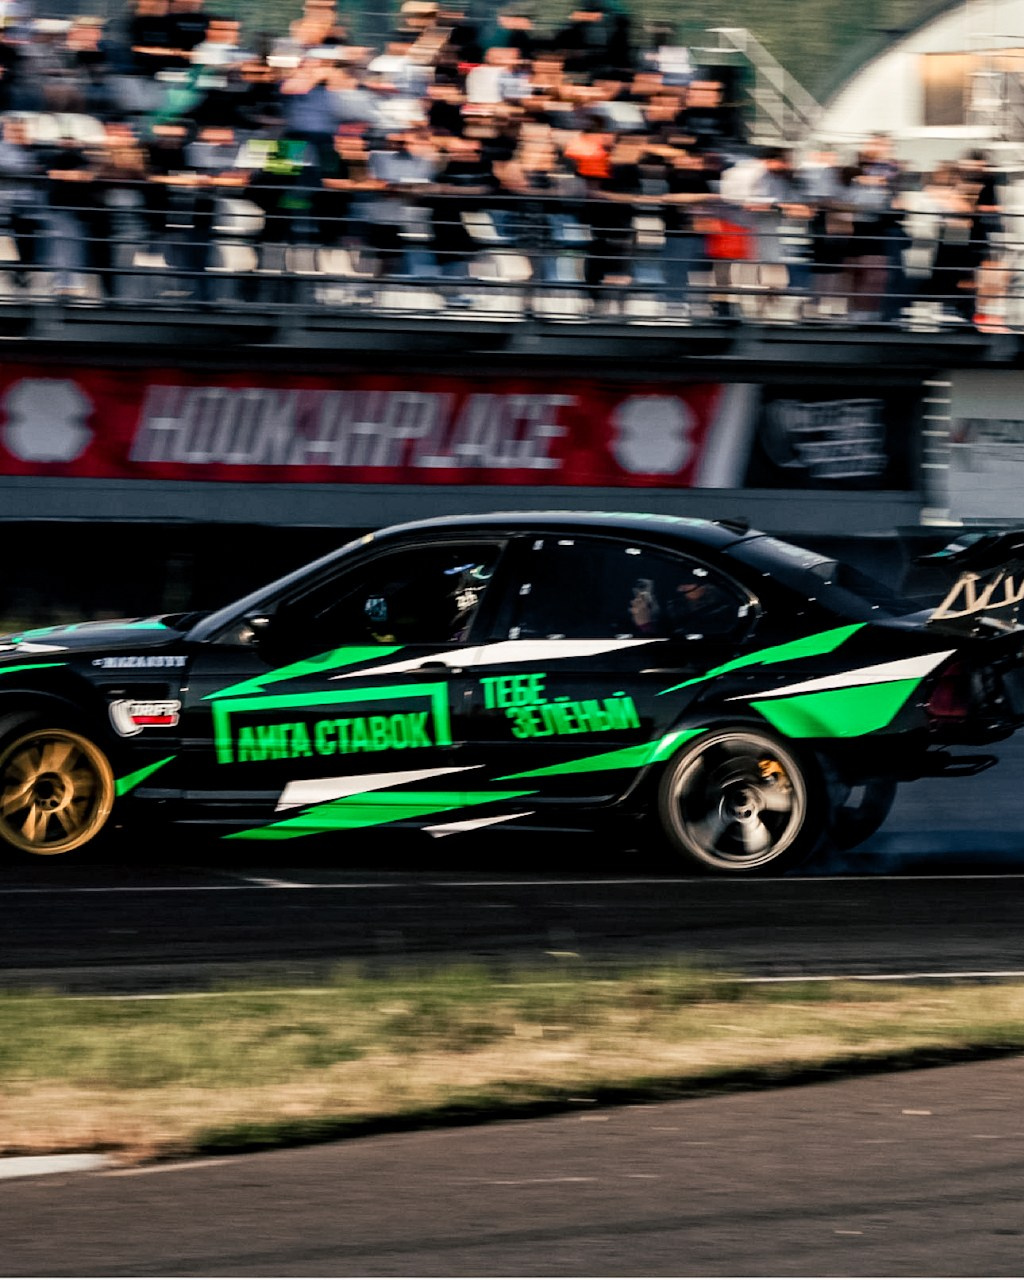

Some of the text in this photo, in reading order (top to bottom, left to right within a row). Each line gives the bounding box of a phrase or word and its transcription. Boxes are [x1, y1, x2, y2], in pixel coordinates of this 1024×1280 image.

[479, 672, 547, 710] ТЕБЕ
[505, 691, 641, 738] ЗЕЛЁНЫЙ
[237, 711, 442, 762] ЛИГА СТАВОК
